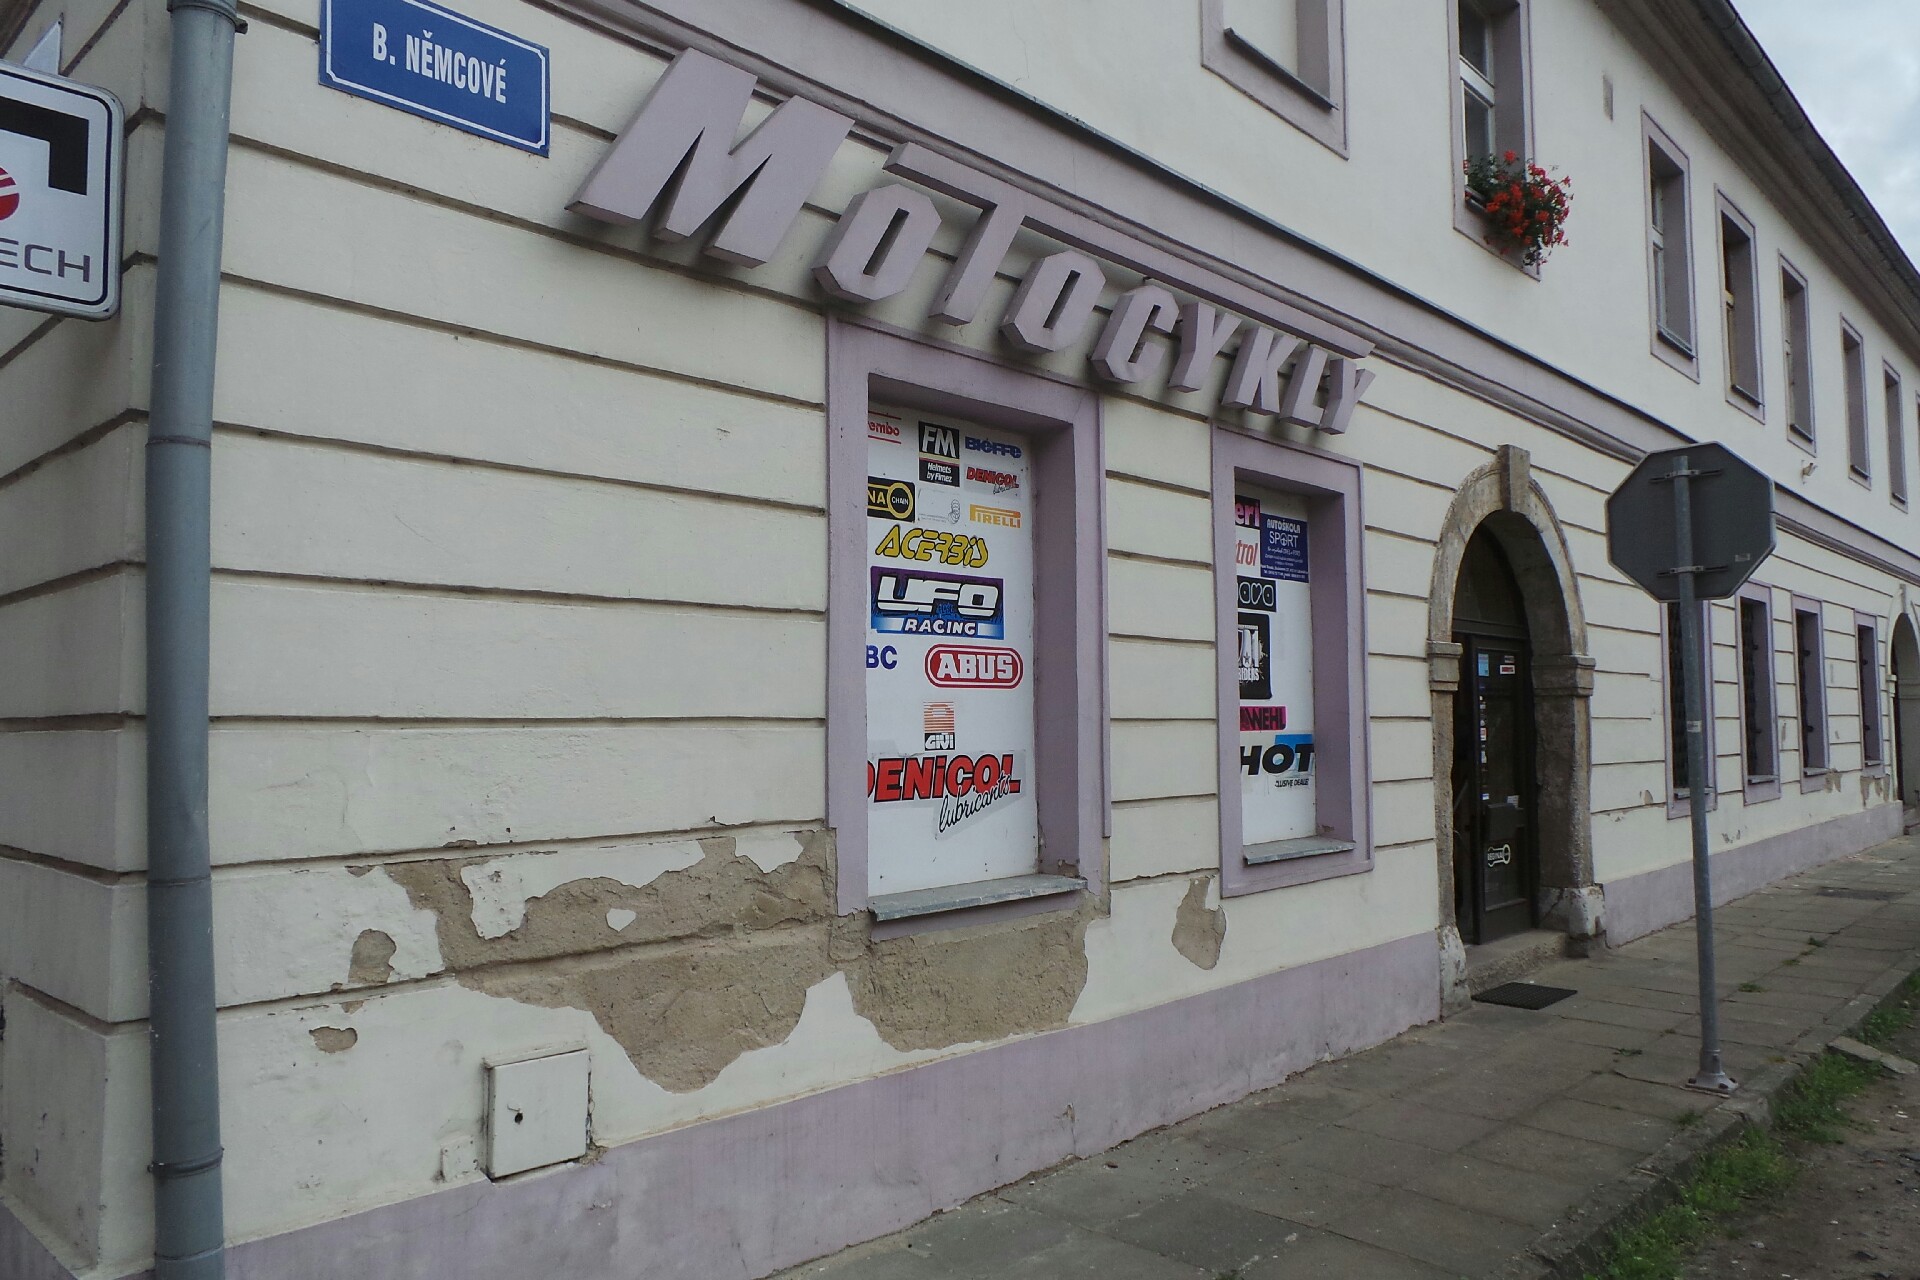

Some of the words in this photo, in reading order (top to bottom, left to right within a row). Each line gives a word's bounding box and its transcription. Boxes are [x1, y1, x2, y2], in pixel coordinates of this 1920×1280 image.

[373, 22, 396, 65] B.
[405, 30, 508, 104] NĚMCOVÉ
[921, 424, 957, 459] FM
[926, 470, 934, 481] by
[927, 462, 952, 474] Helmets
[891, 495, 909, 506] CHAIN
[969, 503, 1021, 529] PIRELLI
[1269, 530, 1299, 549] SPORT
[877, 575, 999, 618] UFO
[904, 618, 977, 635] RACING
[937, 653, 1013, 680] ABUS
[938, 770, 1012, 833] lubricants
